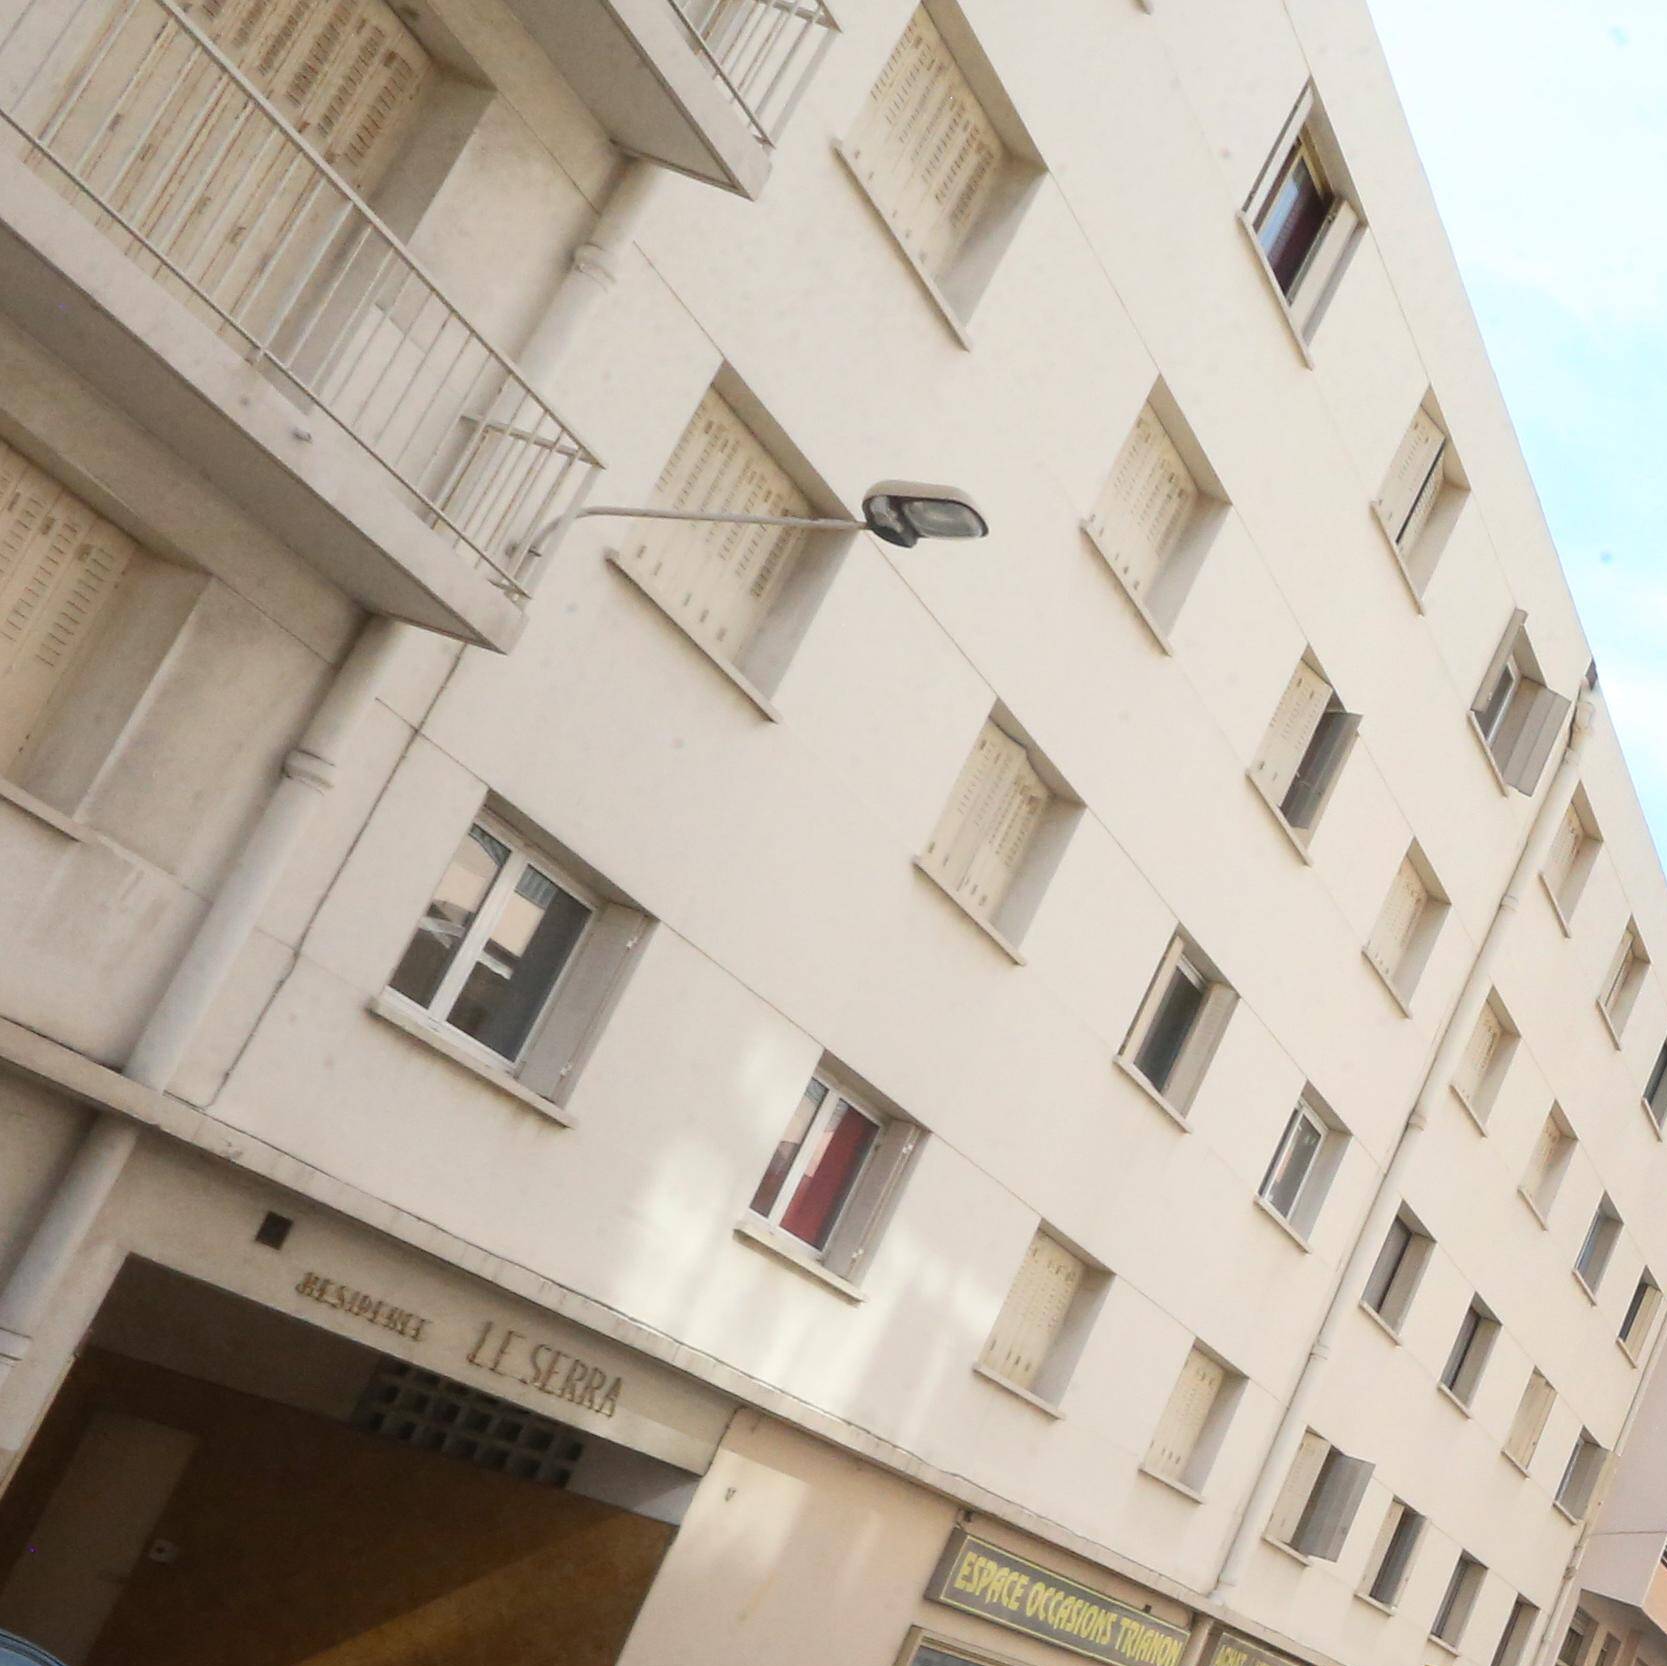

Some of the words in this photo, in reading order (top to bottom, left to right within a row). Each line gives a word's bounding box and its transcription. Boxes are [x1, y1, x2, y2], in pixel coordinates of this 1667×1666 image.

[294, 1271, 433, 1342] RESIDENCE
[466, 1321, 528, 1384] LE
[524, 1343, 624, 1419] SERRA
[953, 1551, 1030, 1612] ESPACE
[1025, 1581, 1118, 1646] OCCASIONS
